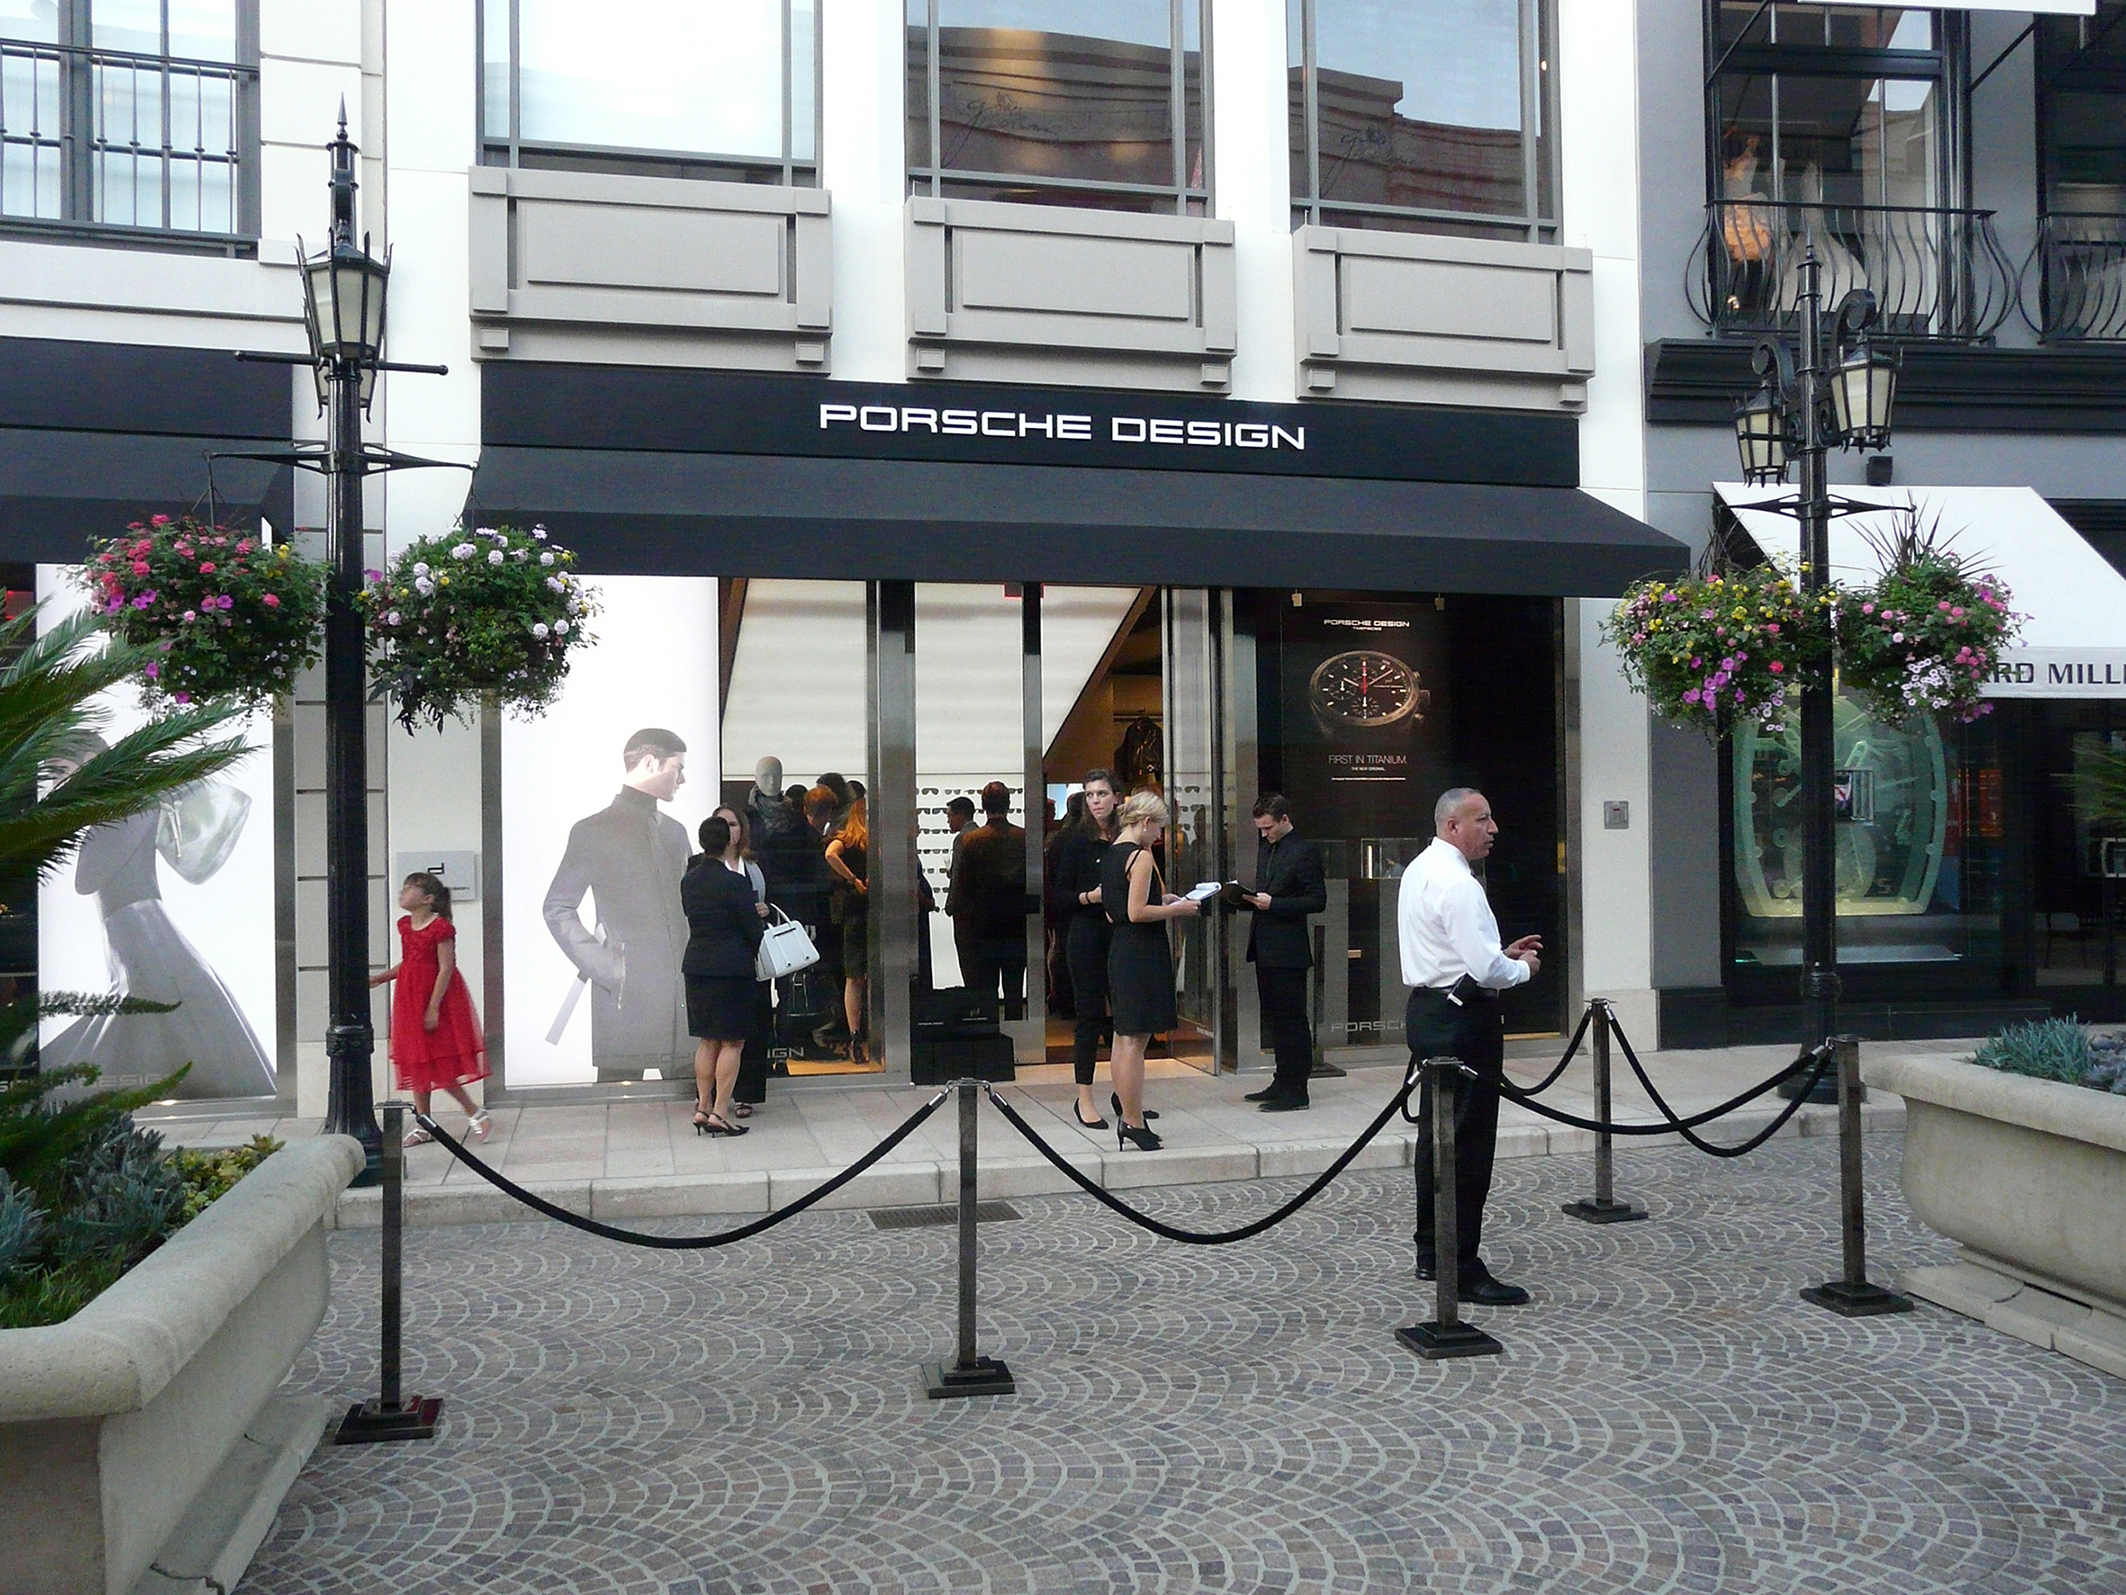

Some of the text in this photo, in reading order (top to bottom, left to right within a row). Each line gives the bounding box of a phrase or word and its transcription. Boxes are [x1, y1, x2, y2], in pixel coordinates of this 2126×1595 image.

[819, 404, 1306, 450] PORSCHE DESIGN
[2048, 663, 2126, 684] MILL
[1328, 754, 1353, 764] FIRST
[1355, 755, 1364, 764] IN
